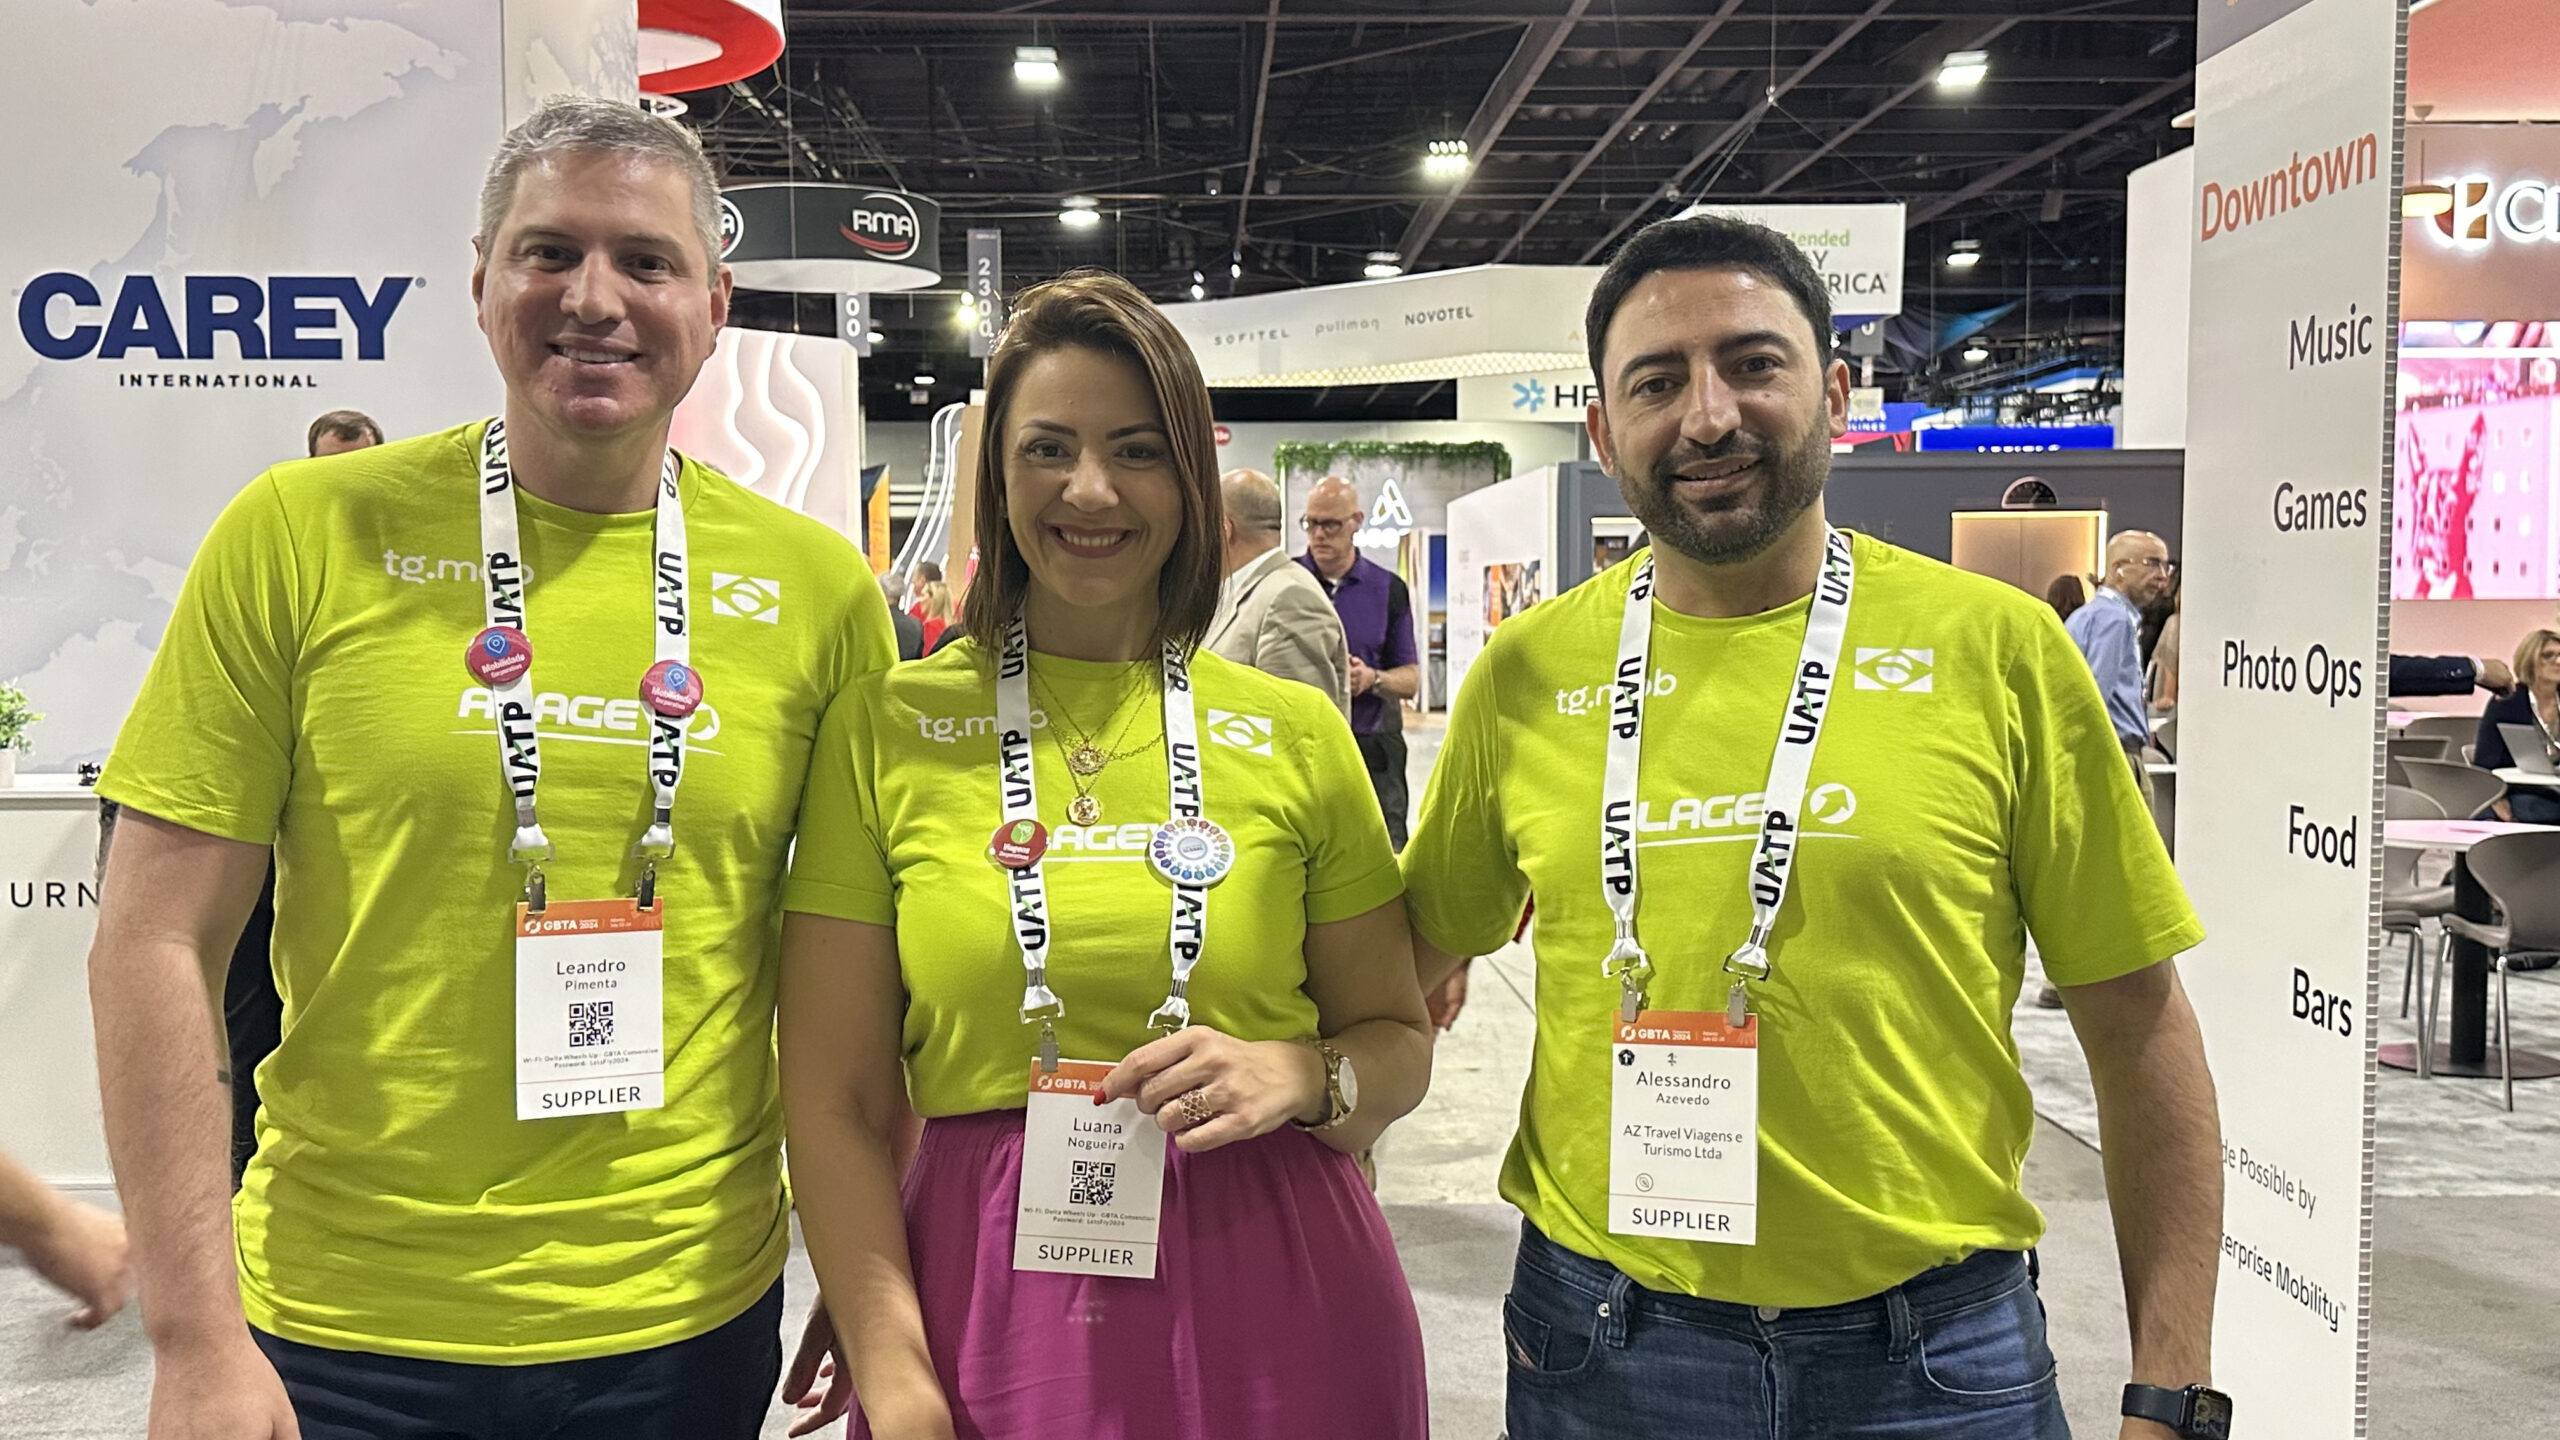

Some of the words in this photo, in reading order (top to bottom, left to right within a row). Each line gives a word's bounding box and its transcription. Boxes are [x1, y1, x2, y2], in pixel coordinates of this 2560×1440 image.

[2201, 132, 2377, 242] Downtown
[852, 209, 913, 238] RMA
[1791, 229, 1850, 247] ended
[978, 257, 993, 337] 2300
[1820, 272, 1886, 294] RICA
[18, 272, 413, 361] CAREY
[845, 293, 861, 337] 00
[1315, 317, 1380, 337] pullman
[1404, 306, 1475, 326] NOVOTEL
[1214, 329, 1291, 346] SOFITEL
[2289, 303, 2373, 370] Music
[119, 374, 318, 388] INTERNATIONAL
[2274, 482, 2367, 532] Games
[383, 549, 535, 584] tg.m
[1630, 554, 1654, 601] ATP
[1821, 533, 1850, 606] UATP
[658, 552, 684, 636] UATP
[1001, 615, 1024, 679] UAT
[1555, 668, 1677, 716] tg.mb
[2223, 640, 2297, 694] Photo
[2305, 644, 2362, 707] Ops
[1612, 656, 1642, 739] UATP
[1785, 660, 1830, 745] UATP
[1001, 729, 1032, 809] UATP
[1172, 742, 1200, 817] UATP
[1637, 792, 1766, 833] LAGE
[1604, 801, 1633, 895] UATP
[2288, 805, 2357, 869] Food
[1755, 810, 1794, 908] UATP
[544, 920, 578, 931] GBTA
[557, 959, 626, 975] Leandro
[565, 979, 618, 991] Pimenta
[2292, 966, 2353, 1038] Bars
[1638, 1028, 1671, 1040] GBTA
[542, 1086, 641, 1110] SUPPLIER
[1055, 1078, 1087, 1090] GBTA
[1636, 1071, 1731, 1090] Alessandro
[1656, 1092, 1710, 1106] Azevedo
[1068, 1136, 1125, 1151] Nogueira
[1073, 1117, 1122, 1134] Luana
[1623, 1124, 1641, 1137] AZ
[1644, 1125, 1681, 1139] Travel
[1683, 1127, 1732, 1143] Viagens
[1735, 1133, 1743, 1143] e
[1643, 1143, 1692, 1158] Turismo
[1694, 1146, 1723, 1160] Ltda
[2221, 1139, 2236, 1168] de
[2240, 1147, 2294, 1202] Possible
[2299, 1179, 2316, 1219] by
[1631, 1208, 1731, 1232] SUPPLIER
[1038, 1244, 1134, 1266] SUPPLIER
